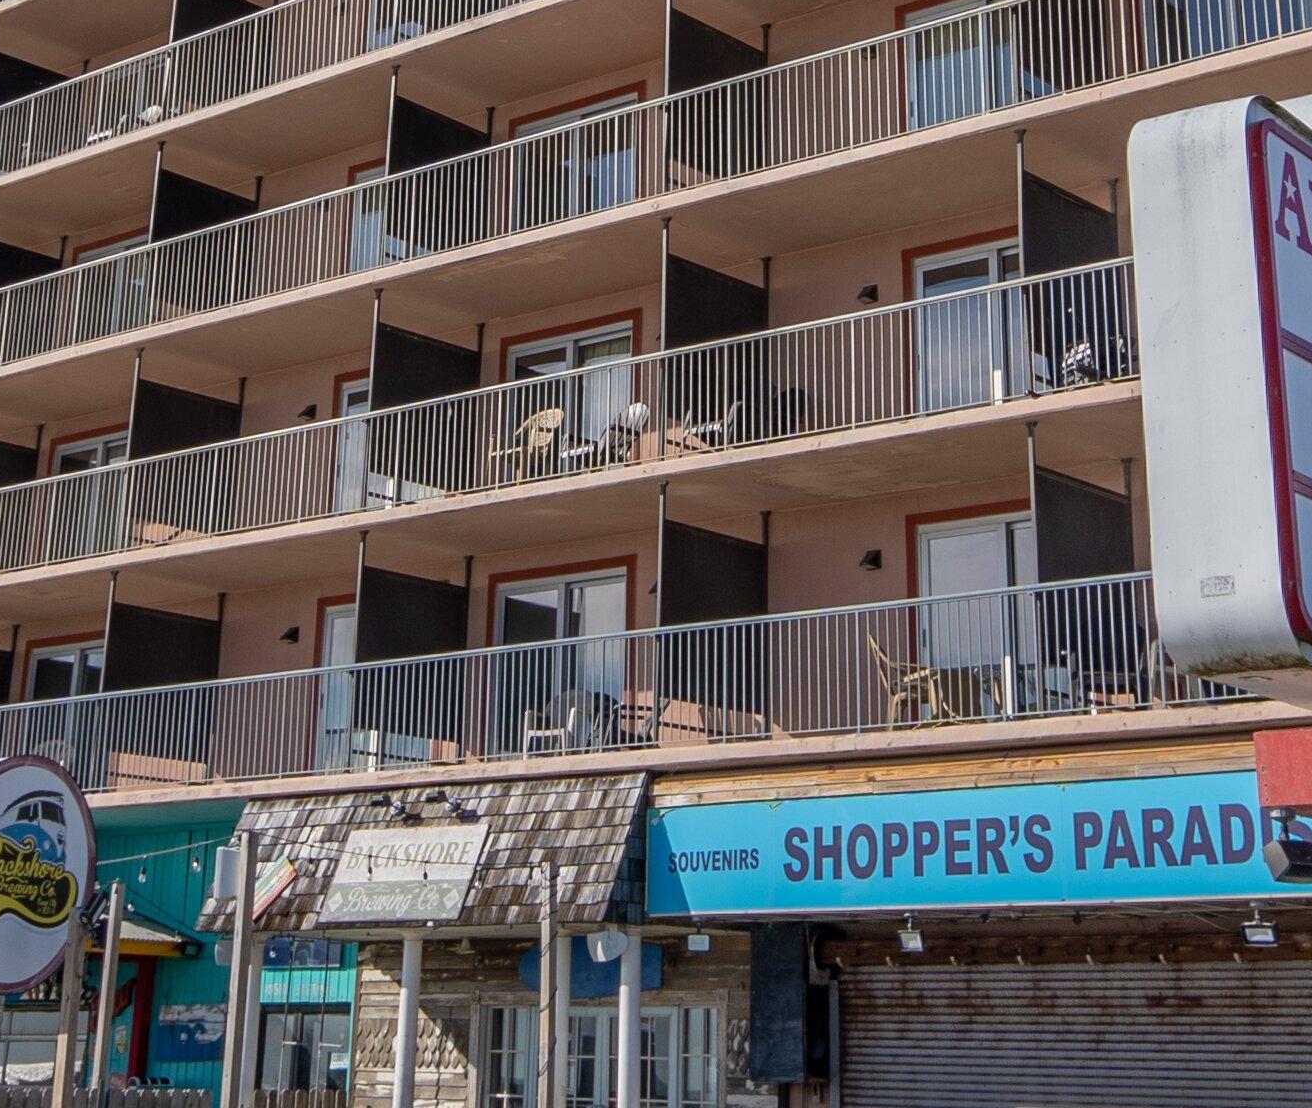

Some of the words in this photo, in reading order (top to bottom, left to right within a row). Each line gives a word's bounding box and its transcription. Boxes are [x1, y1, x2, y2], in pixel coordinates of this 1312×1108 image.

[346, 841, 474, 870] BACKSHORE
[668, 848, 760, 874] SOUVENIRS
[783, 814, 1055, 883] SHOPPER'S
[343, 886, 413, 915] Brewing
